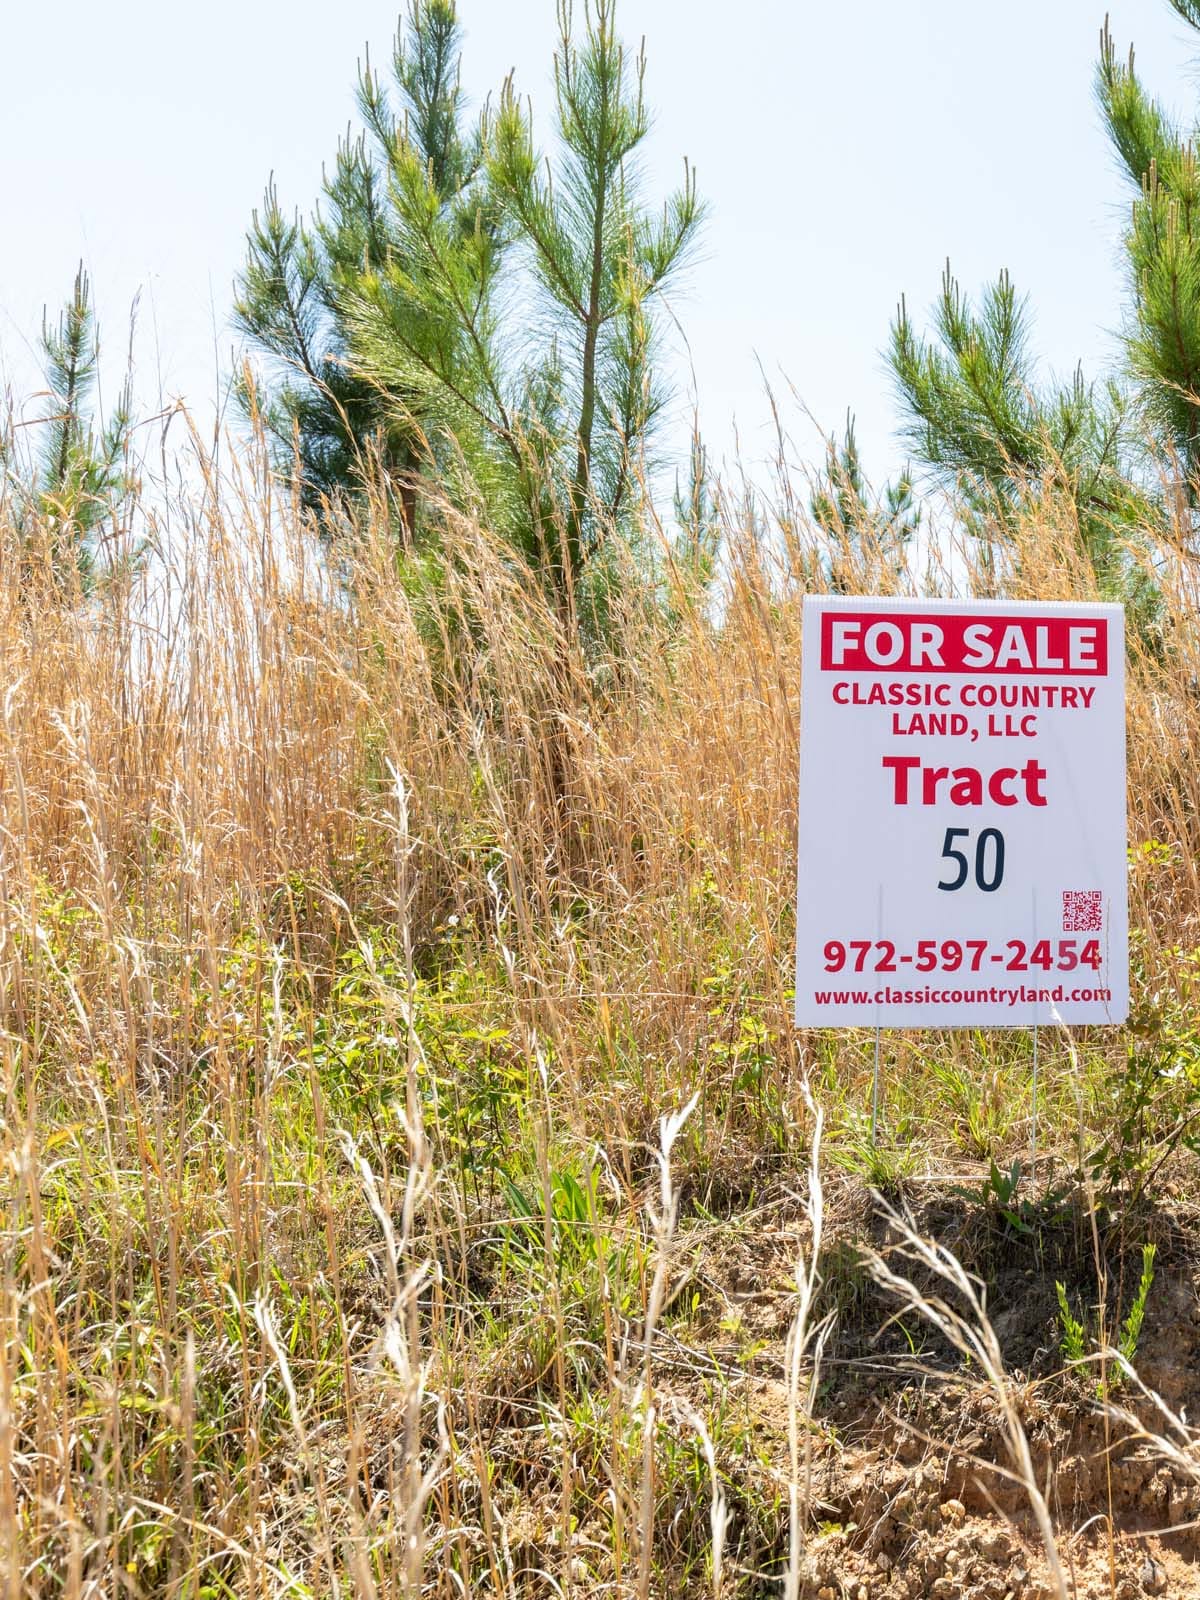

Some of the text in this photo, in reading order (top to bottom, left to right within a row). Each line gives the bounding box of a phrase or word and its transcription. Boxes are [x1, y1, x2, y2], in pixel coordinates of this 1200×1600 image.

[831, 621, 1098, 670] FOR SALE
[832, 682, 1096, 709] CLASSIC COUNTRY
[892, 713, 1038, 742] LAND, LLC
[882, 756, 1048, 807] Tract
[937, 827, 1005, 892] 50
[823, 940, 1102, 972] 972-597-2454
[814, 985, 1111, 1005] www.classiccountryland.com
